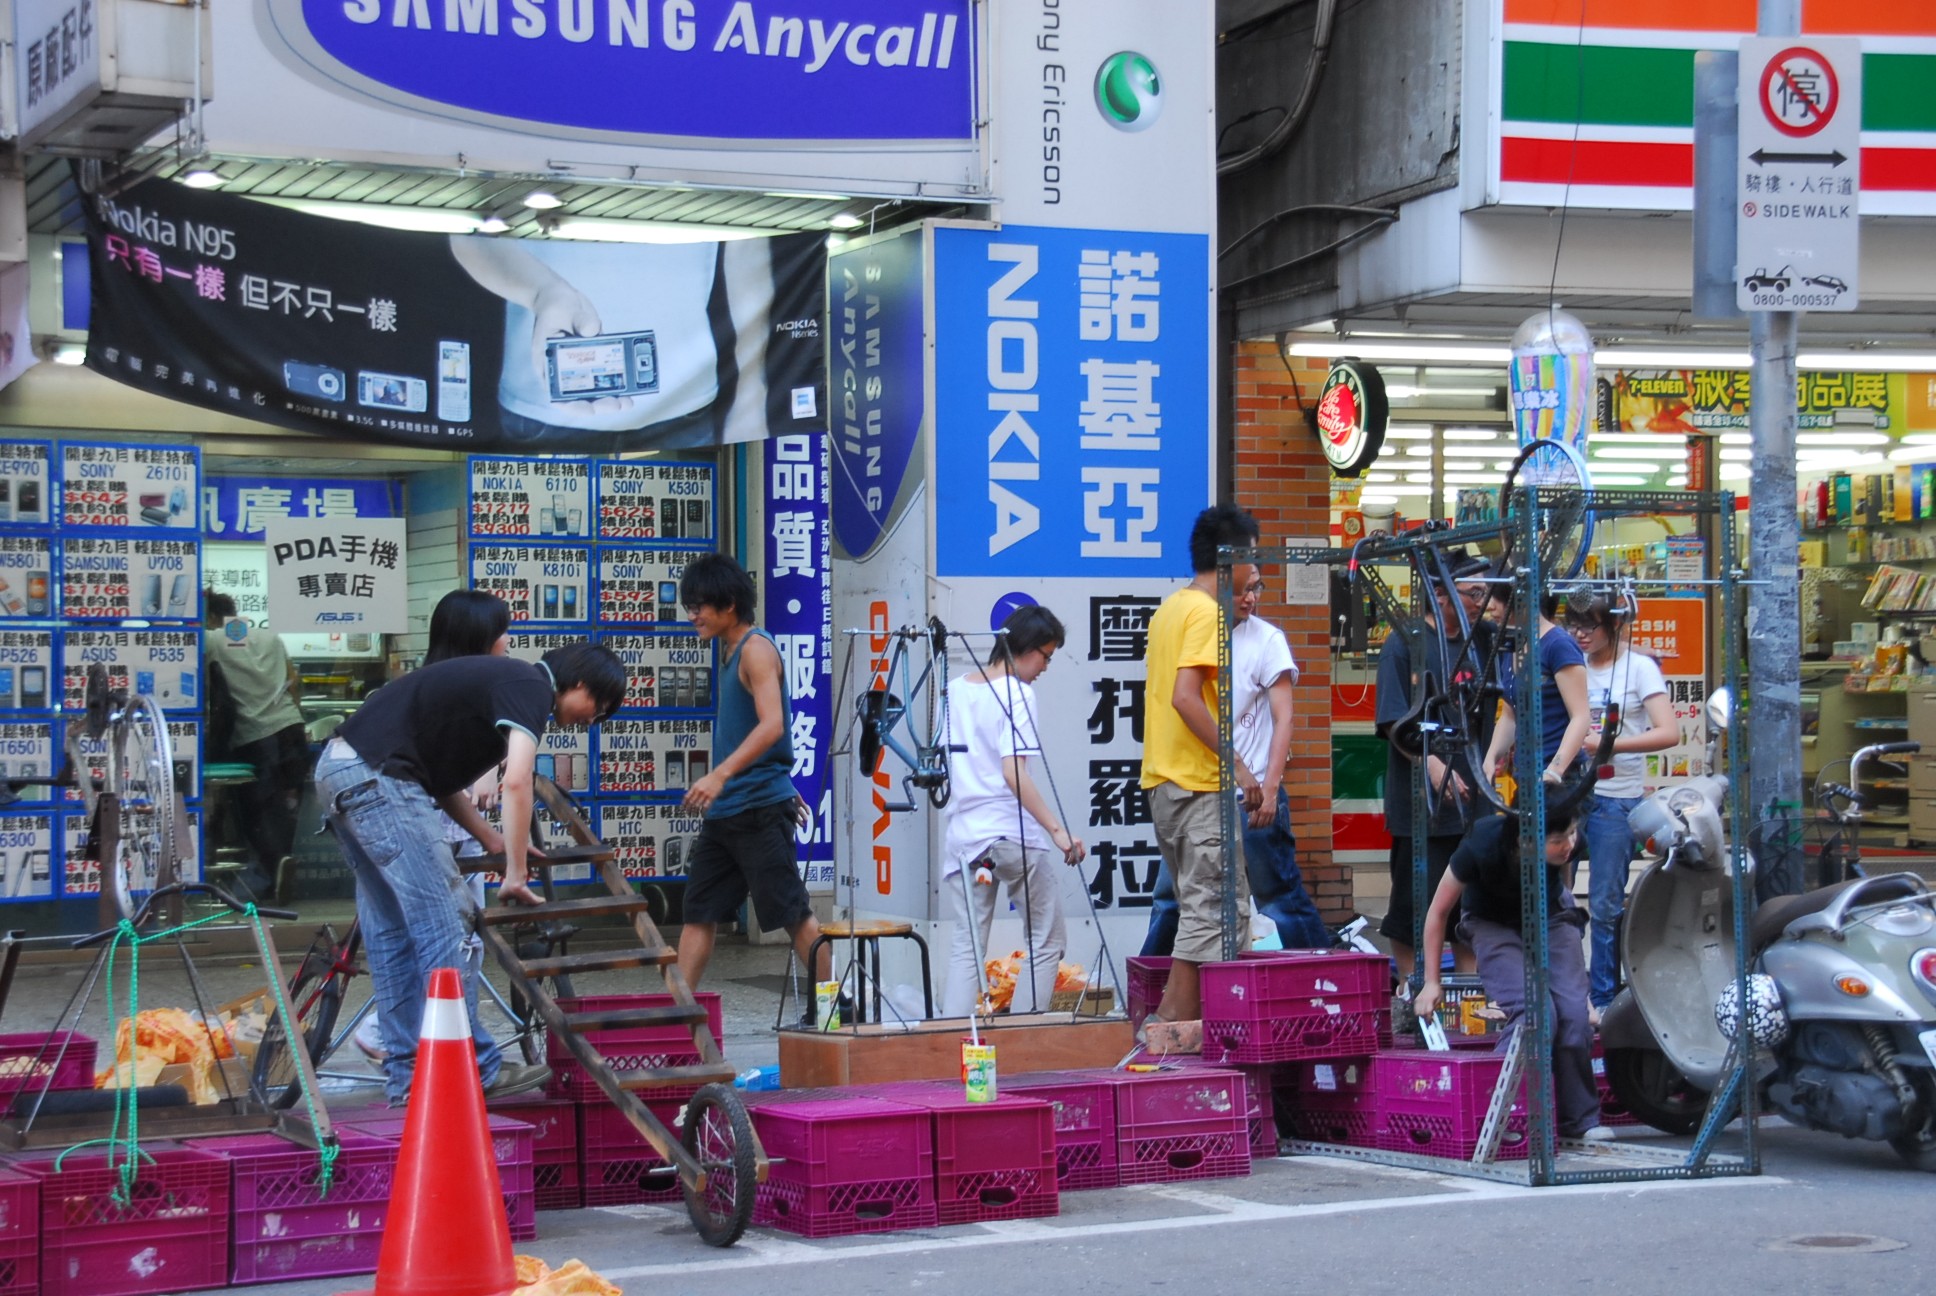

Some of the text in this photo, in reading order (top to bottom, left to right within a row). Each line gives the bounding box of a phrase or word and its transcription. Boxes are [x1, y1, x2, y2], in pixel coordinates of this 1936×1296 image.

[714, 2, 957, 72] Anycall
[1777, 68, 1821, 119] 停
[1043, 64, 1066, 205] Ericsson
[1763, 205, 1850, 218] SIDEWALK
[98, 194, 236, 260] Nokia N95
[106, 234, 398, 333] 只有一樣 但不只一樣
[1753, 294, 1837, 307] 0800-000537
[776, 319, 818, 332] NOKIA
[841, 268, 861, 455] Anycall
[865, 260, 882, 512] SAMSUNG
[1694, 370, 1887, 408] 秋品展
[987, 242, 1040, 558] NOKIA
[1078, 249, 1162, 558] 諾基亞
[457, 427, 474, 437] GPS
[65, 447, 196, 465] 開學九月 輕鬆特價
[79, 463, 188, 481] SONY Z610i
[473, 461, 588, 477] 開學九月 輕鬆特價
[601, 466, 711, 481] 開學九月 輕鬆特價
[483, 477, 577, 492] NOKIA 6110
[613, 480, 704, 495] SONY K530i
[64, 492, 128, 504] $642
[473, 503, 530, 514] $1217
[601, 506, 655, 518] $625
[64, 515, 129, 526] $2400
[473, 523, 530, 534] $9300
[601, 527, 655, 538] $2200
[65, 540, 197, 556] 開學九月 輕鬆特價
[273, 534, 399, 570] PDA手機
[474, 547, 588, 563] 開學九月 輕鬆特價
[65, 556, 184, 571] SAMSUNG U708
[601, 550, 654, 564] 開學九月
[485, 562, 580, 577] SONY K810i
[612, 564, 643, 578] SONY
[64, 584, 130, 596] $1166
[297, 572, 376, 598] 專賣店
[601, 591, 655, 602] $592
[64, 607, 130, 617] $8700
[315, 612, 356, 621] ASUS
[601, 612, 655, 622] $1800
[65, 632, 197, 647] 開學九月 輕鬆特價
[659, 636, 711, 650] 輕鬆特價
[80, 648, 185, 662] ASUS P535
[668, 650, 704, 664] K800i
[64, 665, 128, 676] 輕購
[600, 720, 711, 734] 開學九月 輕鬆特價
[80, 739, 107, 753] SON
[610, 734, 697, 749] NOKIA N76
[1087, 594, 1161, 909] 摩托羅拉
[600, 762, 655, 773] $1158
[600, 783, 655, 792] $8600
[602, 806, 656, 819] 開學九月
[618, 821, 642, 834] HTC
[614, 847, 656, 858] 1175
